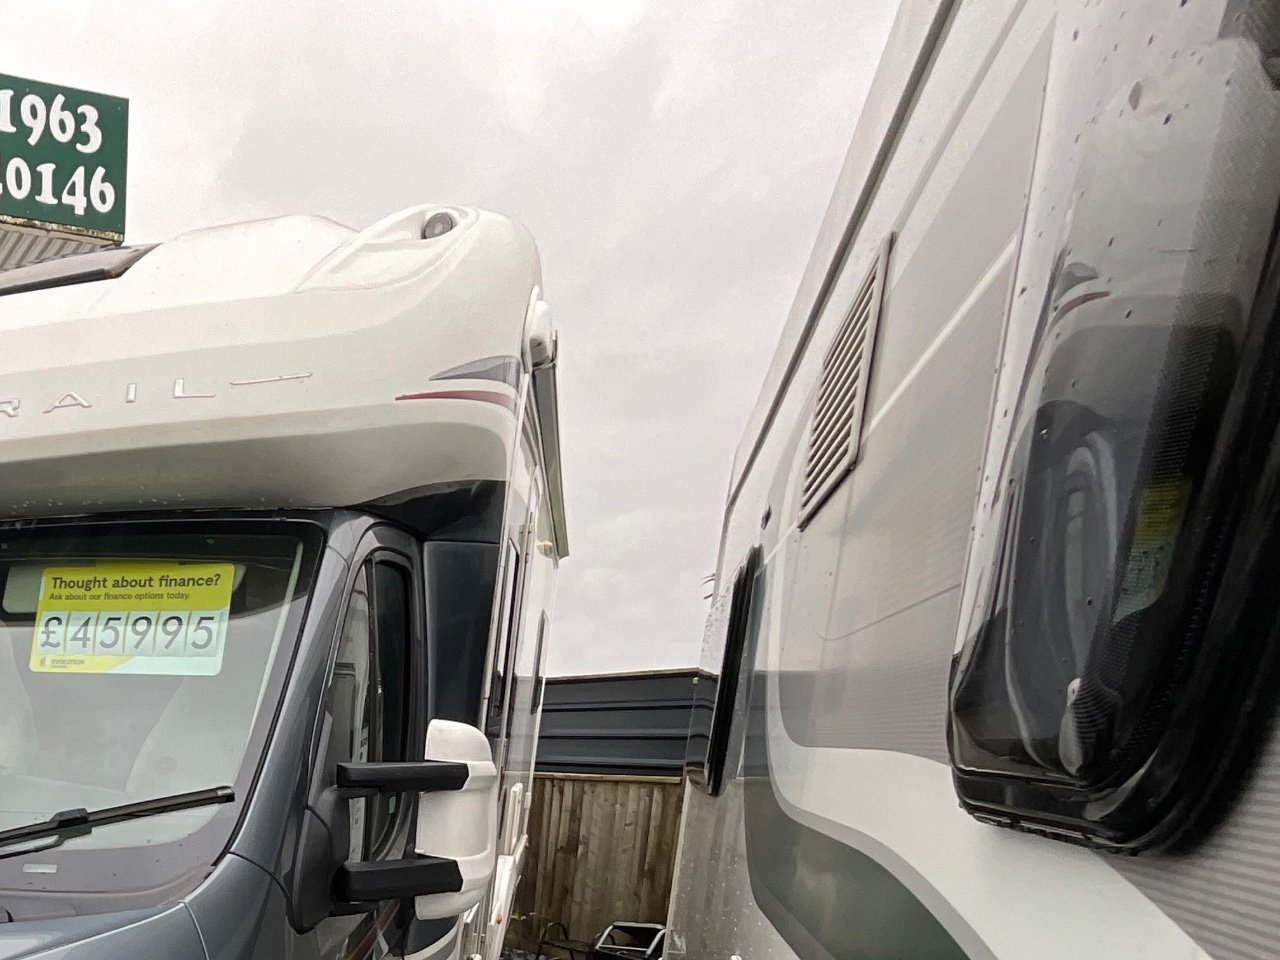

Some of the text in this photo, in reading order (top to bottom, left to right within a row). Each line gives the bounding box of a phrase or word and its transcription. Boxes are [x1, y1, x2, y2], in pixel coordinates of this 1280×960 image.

[51, 573, 221, 591] Thought about finance?
[104, 592, 132, 600] finance
[134, 592, 164, 601] options
[166, 591, 191, 600] today.
[40, 615, 215, 650] £45995
